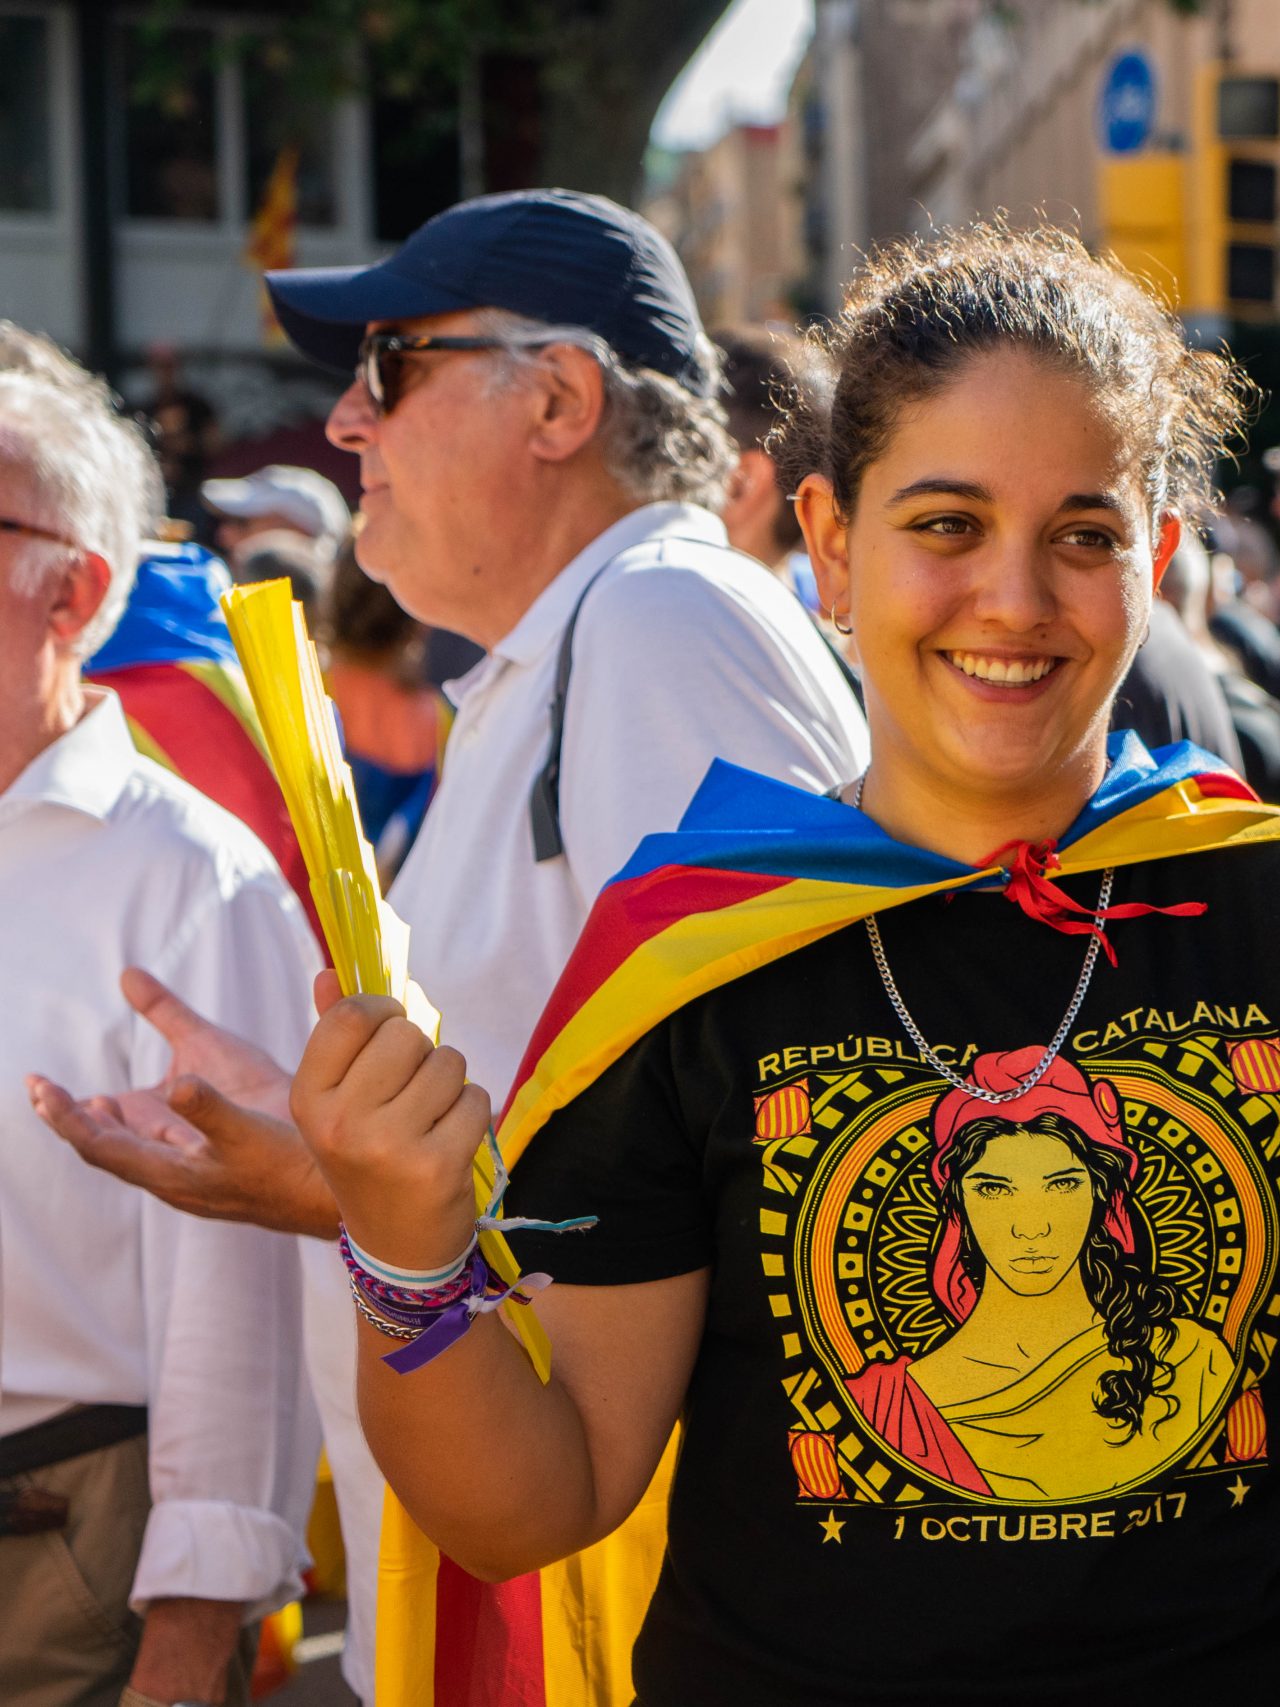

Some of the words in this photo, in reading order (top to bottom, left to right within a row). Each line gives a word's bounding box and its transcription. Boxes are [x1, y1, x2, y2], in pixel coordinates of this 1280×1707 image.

[758, 1034, 979, 1082] REPÚBLICA
[1072, 1001, 1271, 1052] CATALANA
[893, 1515, 905, 1540] 1
[921, 1510, 1116, 1542] OCTUBRE
[1121, 1492, 1187, 1534] 2017
